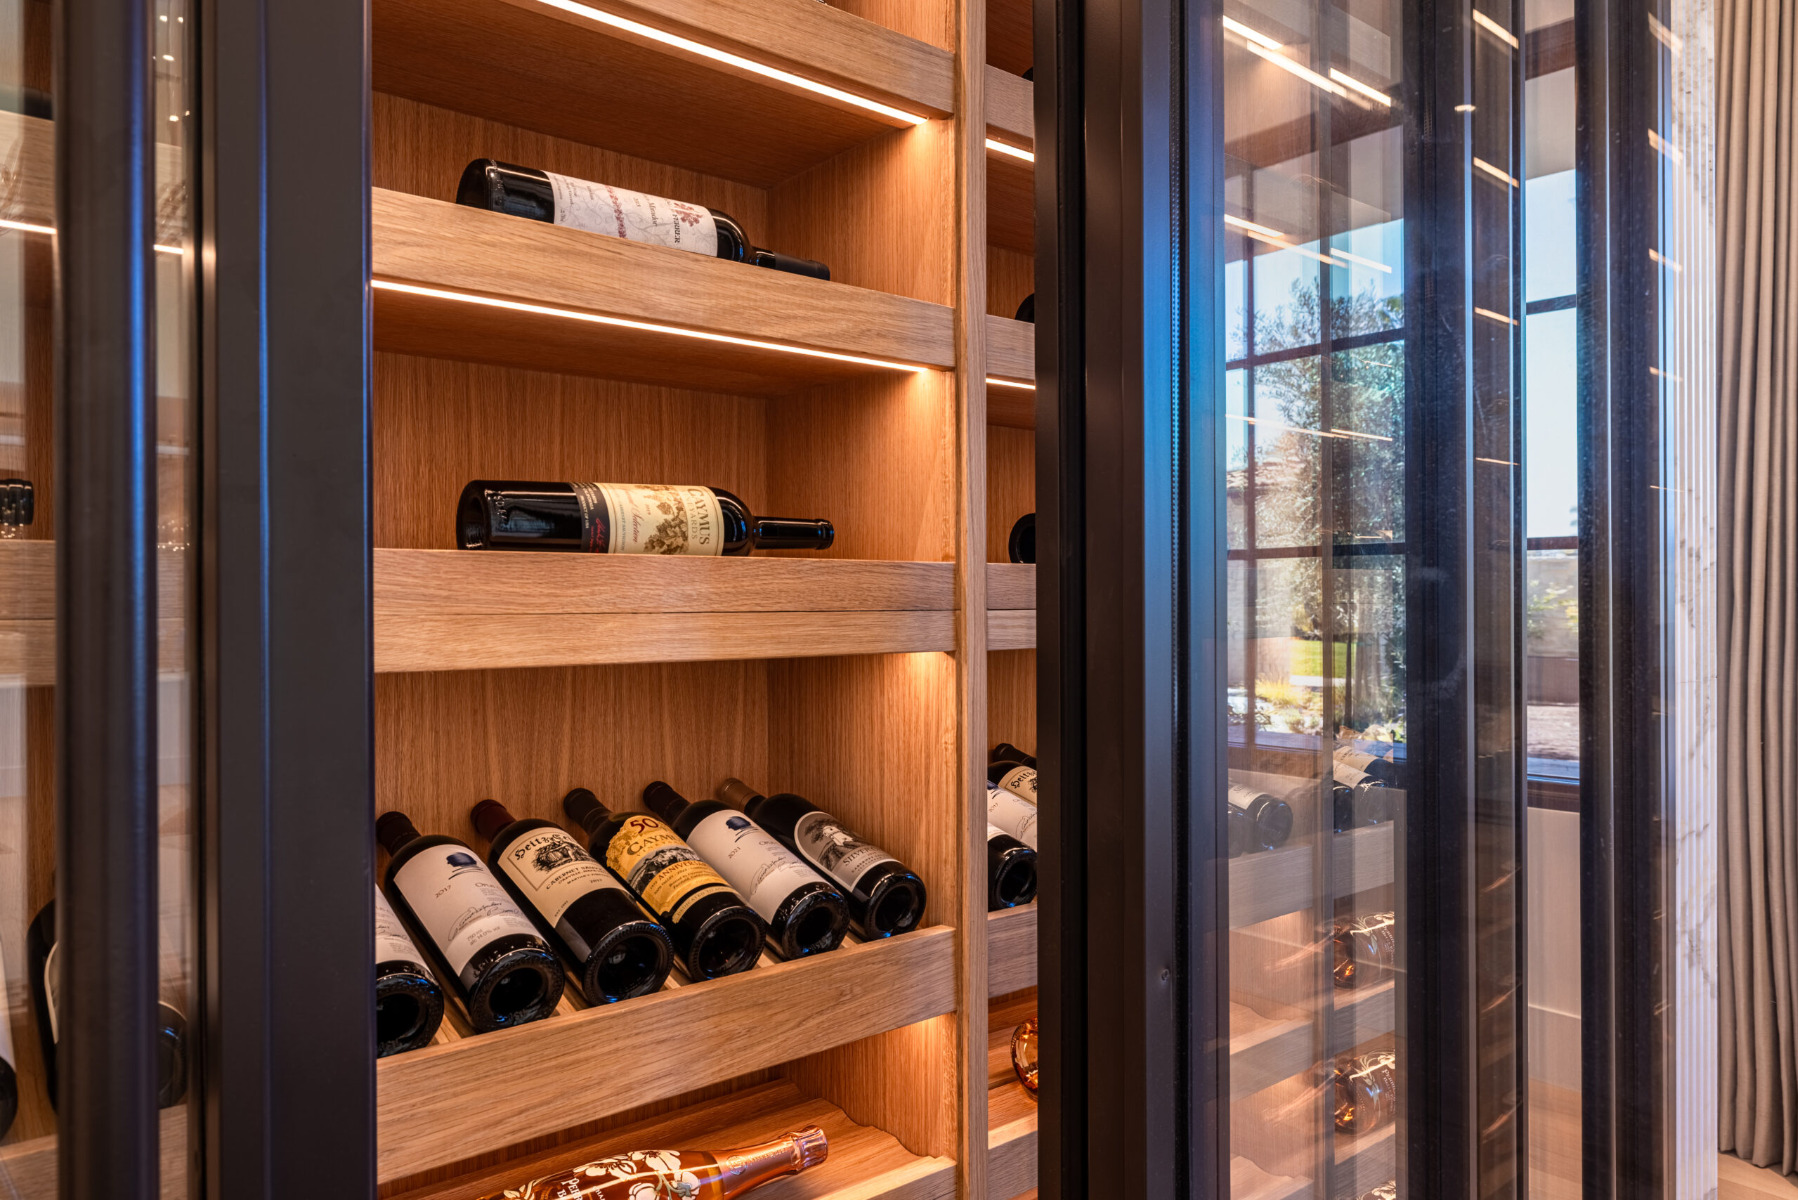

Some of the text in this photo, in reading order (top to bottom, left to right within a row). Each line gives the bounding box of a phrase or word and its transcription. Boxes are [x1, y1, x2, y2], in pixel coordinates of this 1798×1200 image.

[688, 488, 710, 545] CAYMUS
[630, 818, 659, 834] 50
[434, 884, 452, 899] 2017
